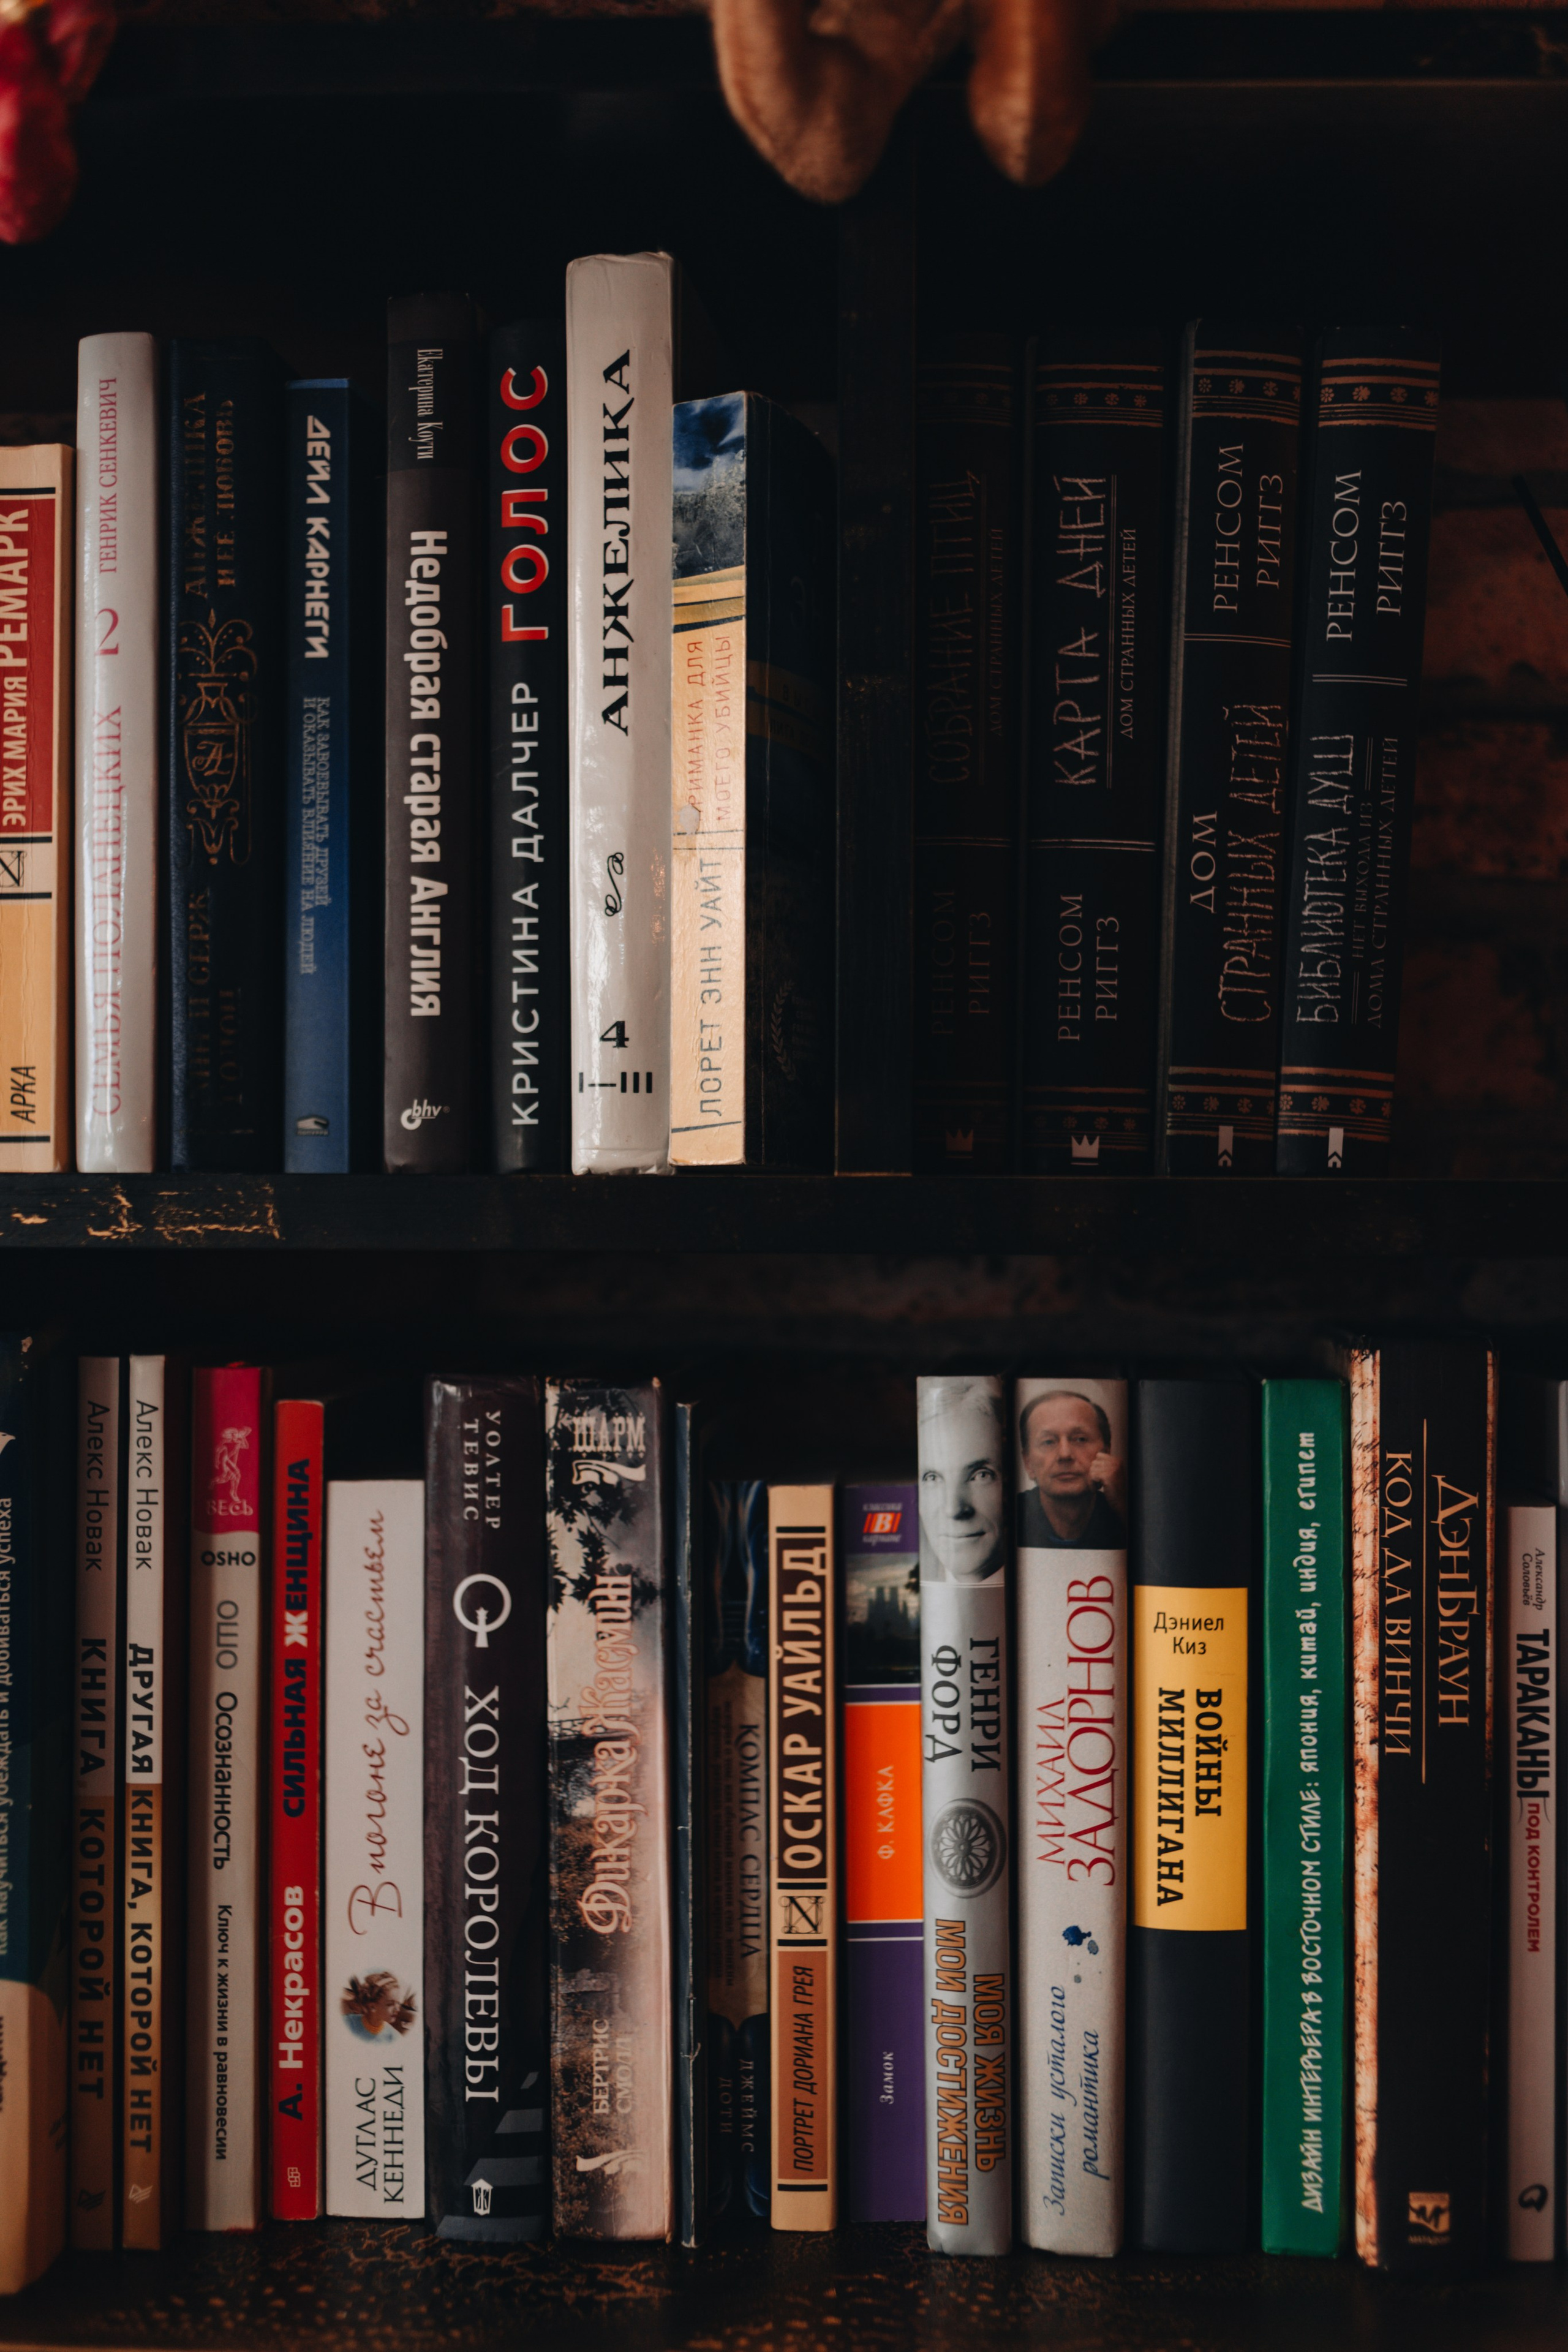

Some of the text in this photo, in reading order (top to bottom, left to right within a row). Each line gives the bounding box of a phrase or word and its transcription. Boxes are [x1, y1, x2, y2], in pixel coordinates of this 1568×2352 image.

[99, 377, 118, 573] ГЕНРИК СЕНКЕВИЧ
[408, 348, 443, 459] Екатерина Коути
[304, 415, 331, 658] ДЕЙЛ КАРНЕГИ
[500, 365, 549, 642] ГОЛОС
[601, 348, 635, 736] АНЖЕЛИКА
[1213, 442, 1244, 614] РЕНСОМ
[1256, 473, 1283, 590] РИГГЗ
[1325, 469, 1362, 643] РЕНСОМ
[1376, 499, 1408, 617] РИГГЗ
[0, 509, 28, 826] ЭРИХ МАРИЯ РЕМАРК
[94, 608, 118, 655] 2
[687, 641, 706, 686] ДЛЯ
[987, 527, 1005, 736] ДОМ СТРАННЫХ ДЕТЕЙ
[1052, 474, 1106, 785] КАРТА ДНЕЙ
[1118, 528, 1136, 740] ДОМ СТРАННЫХ ДЕТЕЙ
[314, 696, 331, 907] КАК ЗАВОЕВЫВАТЬ ДРУЗЕЙ
[404, 530, 448, 1017] Недобрая старая Англия
[712, 636, 733, 821] МОЕГО УБИЙЦЫ
[298, 697, 317, 975] И ОКАЗЫВАТЬ ВЛИЯНИЕ НА ЛЮДЕЙ
[511, 682, 544, 1125] КРИСТИНА ДАЛЧЕР
[1189, 810, 1218, 913] ДОМ
[1217, 704, 1283, 1022] СТРАННЫХ ДЕТЕЙ
[1295, 734, 1354, 1023] БИБЛИОТЕКА ДУШ
[1352, 802, 1374, 958] НЕТ ВЫХОДА ИЗ
[1368, 736, 1399, 1029] ДОМА СТРАННЫХ ДЕТЕЙ
[599, 1020, 629, 1048] 4
[695, 858, 723, 1117] ЛОРЕТ ЭНН УАЙТ
[930, 889, 957, 1036] РЕНСОМ
[968, 910, 992, 1016] РИГГЗ
[1057, 892, 1083, 1042] РЕНСОМ
[1095, 915, 1120, 1022] РИГГЗ
[10, 1065, 36, 1123] АРКА
[93, 991, 122, 1117] СЕМЬЯ
[85, 1400, 110, 1571] Алекс Новак
[135, 1400, 159, 1570] Алекс Новак
[463, 1418, 479, 1521] ТЕВИС
[484, 1410, 501, 1529] УОЛТЕР
[572, 1412, 646, 1458] ШАРМ
[0, 1497, 16, 1564] успеха
[201, 1551, 256, 1566] OSHO
[1381, 1450, 1412, 1757] КОД ДА ВИНЧИ
[1521, 1553, 1532, 1606] Соловьёв
[1531, 1547, 1546, 1610] Александр
[216, 1600, 239, 1669] ОШО
[282, 1458, 312, 1818] СИЛЬНАЯ ЖЕНЩИНА
[775, 1546, 826, 1869] ОСКАР УАЙЛЬД
[924, 1645, 963, 1763] ФОРД
[970, 1636, 1001, 1773] ГЕНРИ
[1153, 1612, 1224, 1633] Дэниел
[1173, 1637, 1207, 1655] Киз
[213, 1691, 238, 1870] Осознанность
[347, 1510, 409, 1936] В погоне за счастьем
[576, 1572, 649, 1934] Дикарка Жасмин
[1036, 1698, 1066, 1864] МИХАИЛ
[1066, 1575, 1120, 1886] ЗАДОРНОВ
[1157, 1687, 1185, 1907] МИЛЛИГАНА
[1195, 1689, 1228, 1816] ВОЙНЫ
[1516, 1628, 1550, 1798] ТАРАКАНЫ
[458, 1684, 500, 2103] ХОД КОРОЛЕВЫ
[735, 1724, 762, 1959] КОМПАС СЕРДЦА
[876, 1765, 895, 1860] Ф. КАФКА
[1292, 1432, 1324, 2214] ДИЗАЙН ИНТЕРЬЕРА В ВОСТОЧНОМ СТИЛЕ: япония, китай, индия, египет
[1525, 1803, 1540, 1952] ПОД КОНТРОЛЕМ
[78, 1809, 110, 2000] КОТОРОЙ
[127, 1643, 157, 2153] ДРУГАЯ КНИГА, КОТОРОЙ НЕТ
[77, 2021, 104, 2099] НЕТ
[213, 1904, 233, 2160] Ключ к жизни равновесии
[278, 1885, 309, 2120] А. Некрасов
[592, 2018, 610, 2114] БЕРТРИС
[615, 2034, 634, 2113] СМОЛЛ
[793, 1965, 817, 2172] ПОРТРЕТ ДОРИАНА ГРЕЯ
[879, 2051, 895, 2104] Замок
[931, 1918, 968, 2226] МОИ ДОСТИЖЕНИЯ
[973, 1972, 1006, 2173] МОЯ ЖИЗНЬ
[355, 2078, 377, 2191] ДУГЛАС
[383, 2065, 405, 2203] КЕННЕДИ
[717, 2076, 733, 2134] ДОТИ
[739, 2059, 758, 2153] ДЖЕЙМС
[1043, 1985, 1077, 2215] Записки усталого
[1079, 2029, 1110, 2180] романтика
